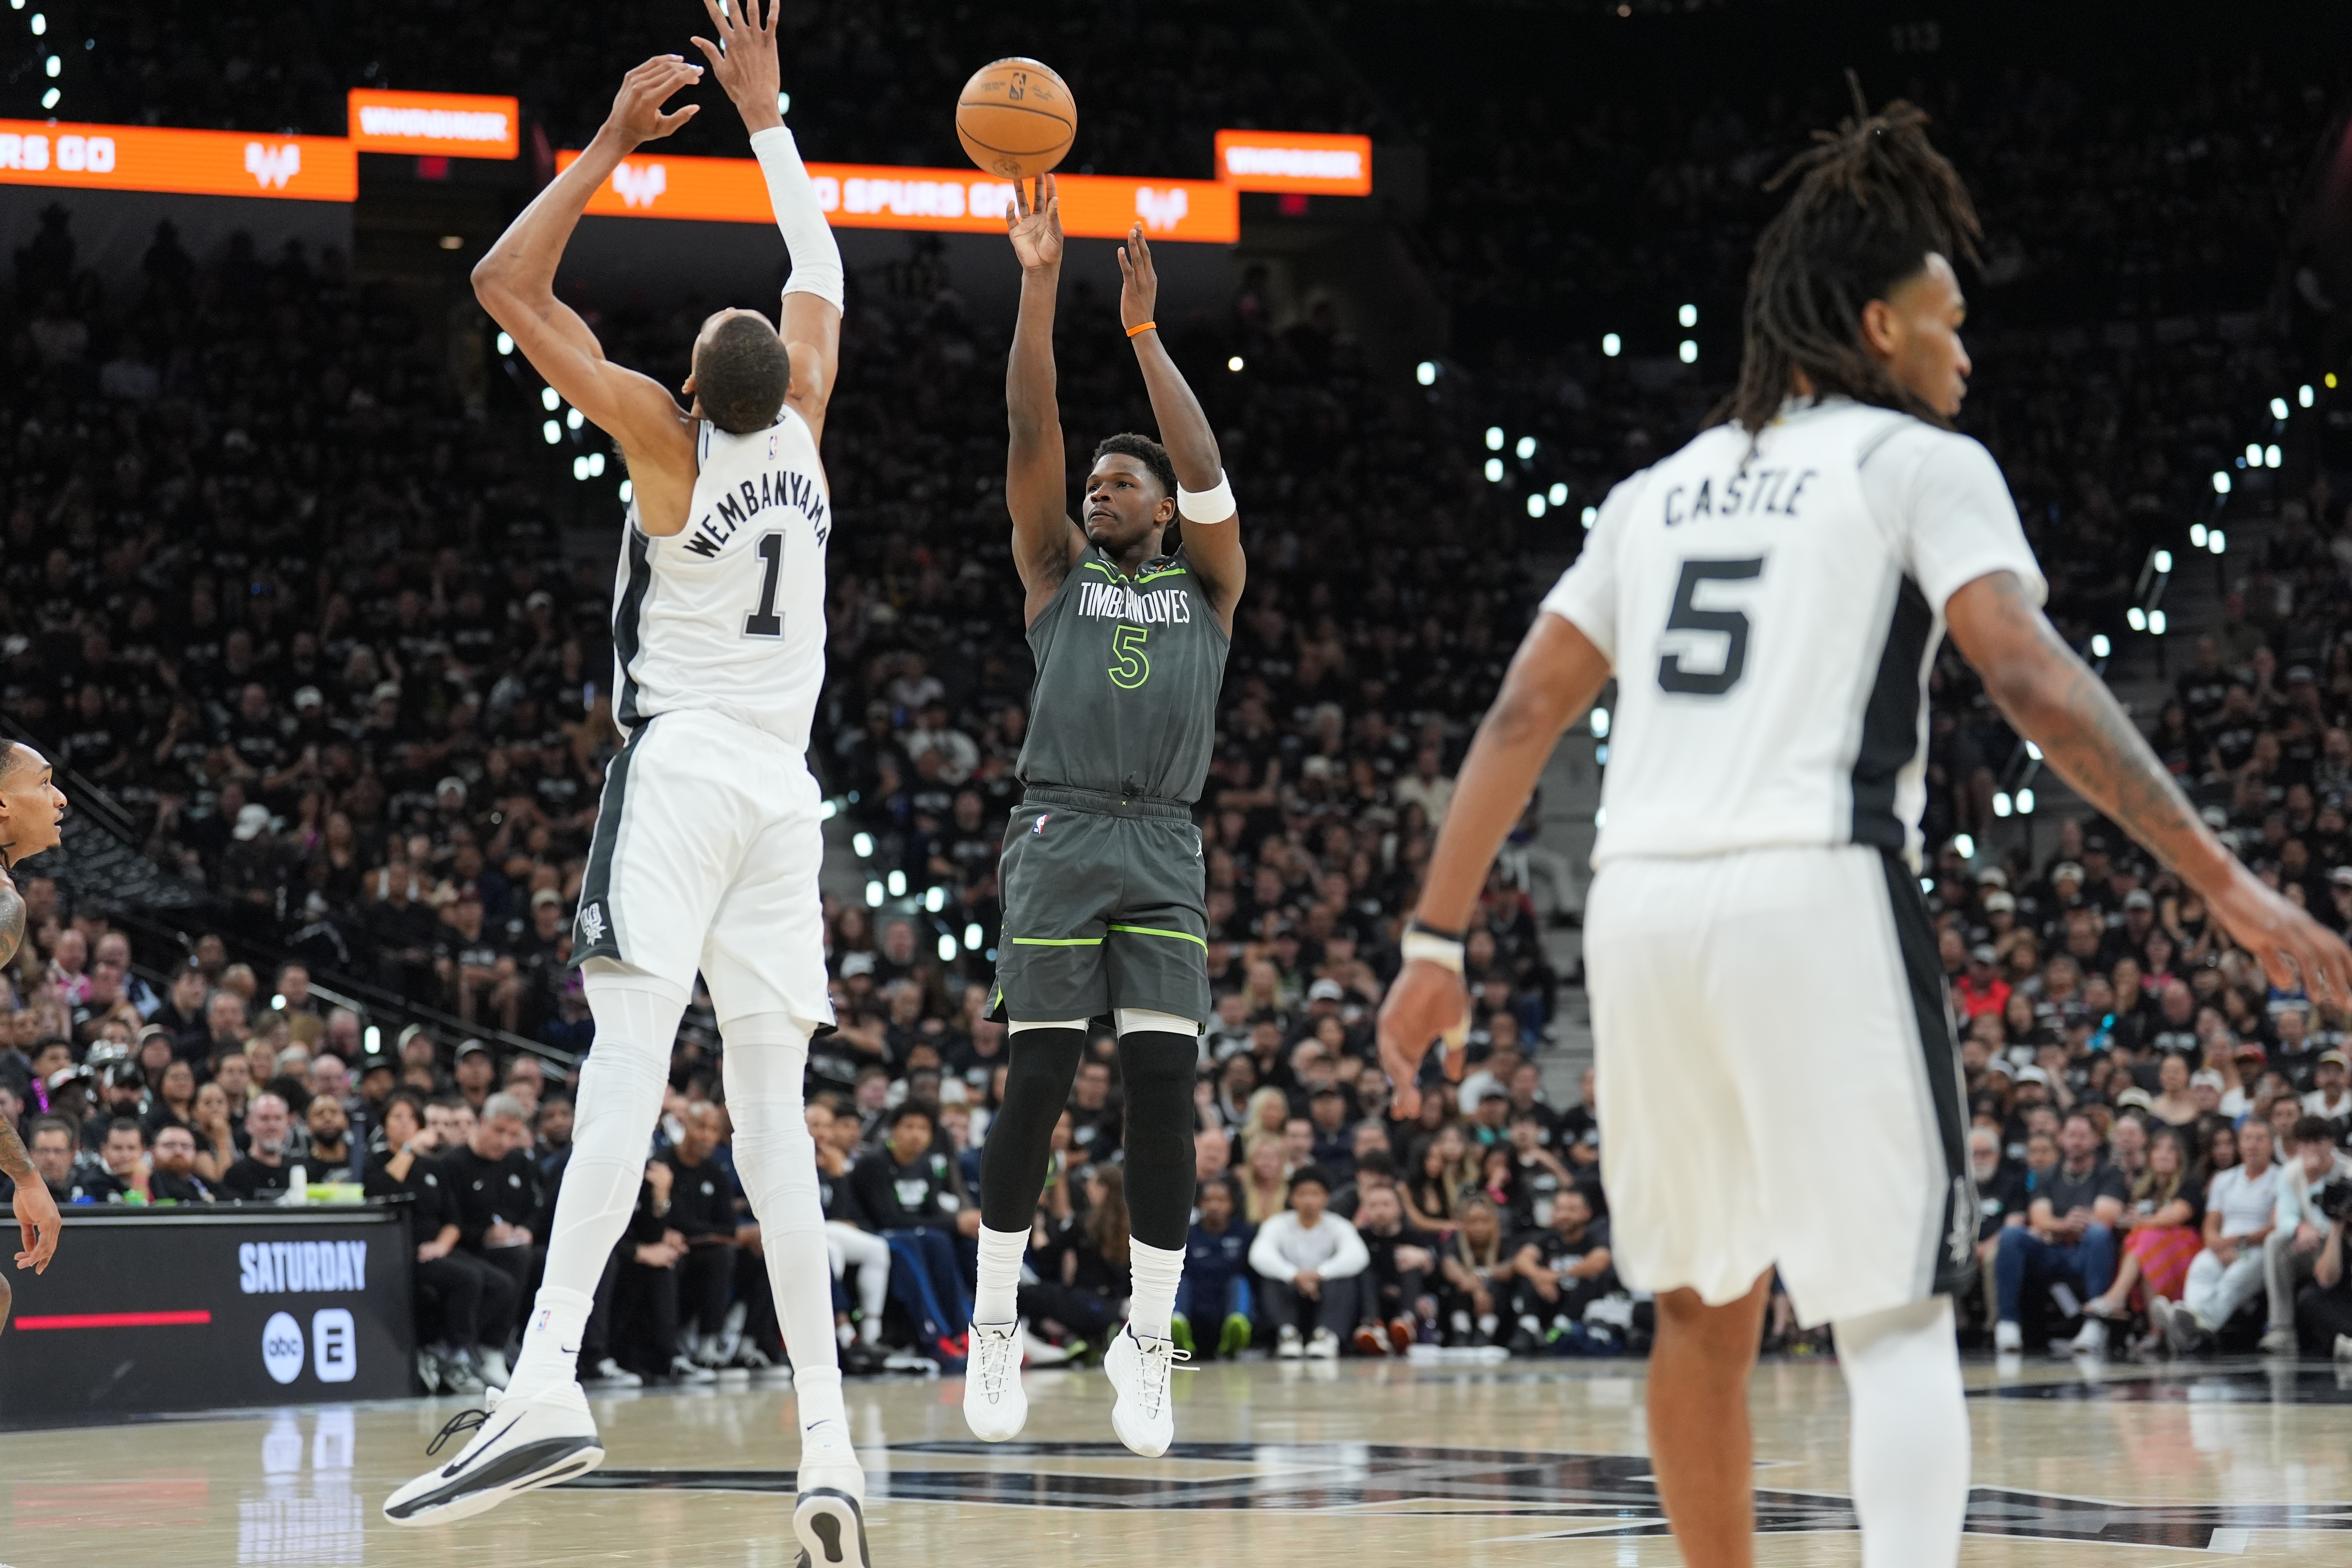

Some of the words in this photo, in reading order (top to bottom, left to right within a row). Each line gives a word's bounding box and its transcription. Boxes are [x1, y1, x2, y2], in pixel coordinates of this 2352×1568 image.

[56, 134, 116, 173] GO
[842, 178, 966, 218] SPURS
[683, 470, 827, 558] WEMBANYAMA
[1663, 470, 1818, 528] CASTLE
[740, 528, 785, 641] 1
[1078, 582, 1190, 629] TIMBERWOLVES
[1656, 552, 1769, 699] 5
[1108, 624, 1150, 689] 5
[239, 1240, 367, 1294] SATURDAY
[269, 1336, 299, 1356] abc
